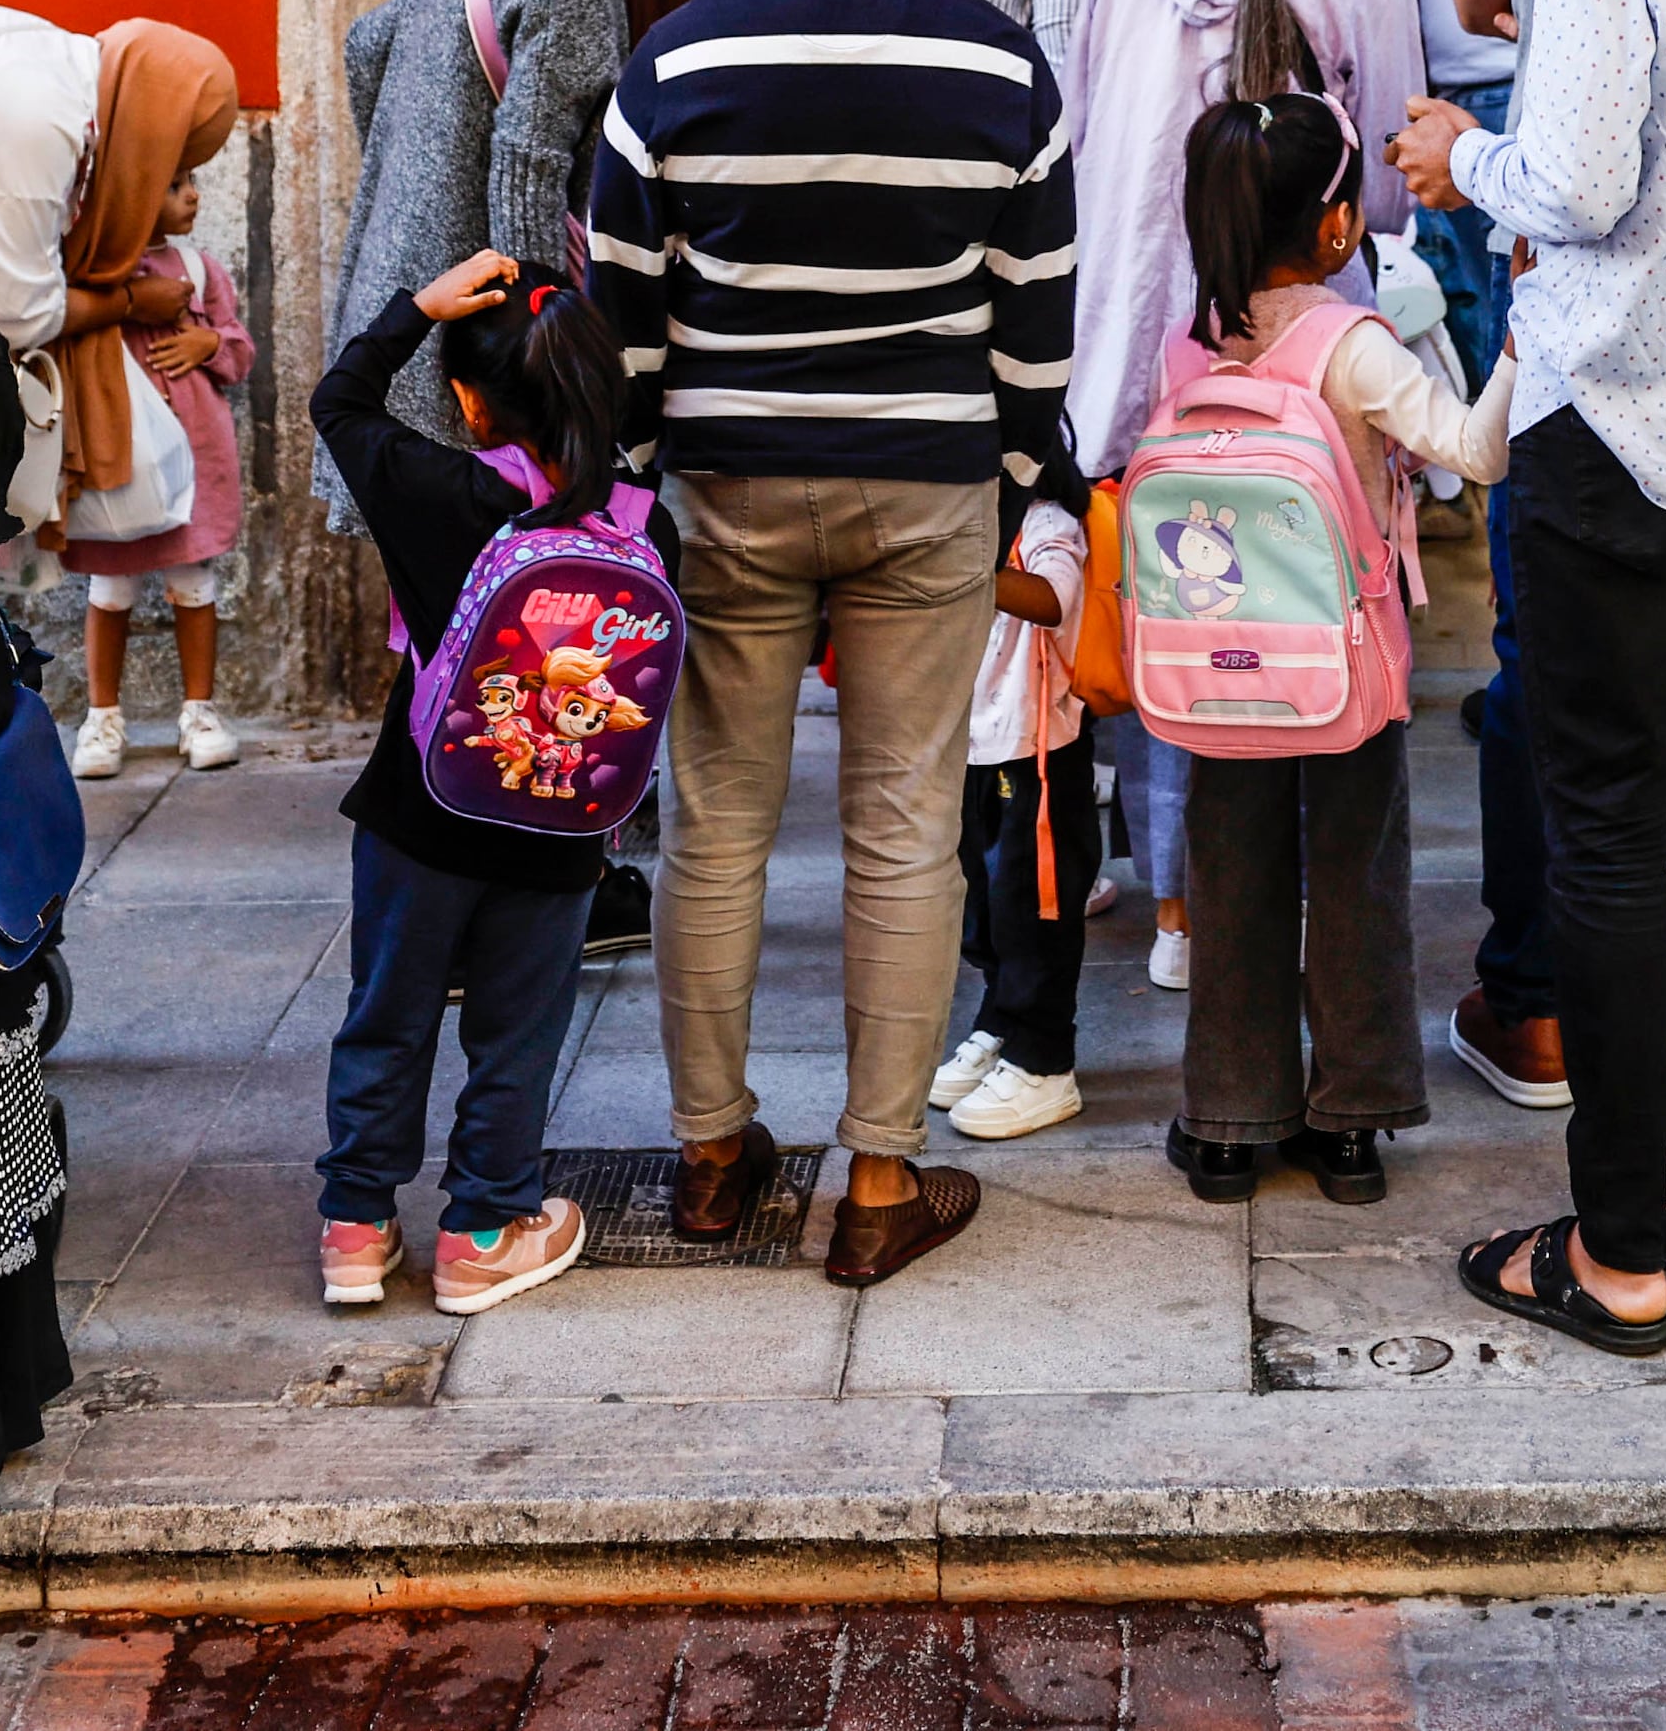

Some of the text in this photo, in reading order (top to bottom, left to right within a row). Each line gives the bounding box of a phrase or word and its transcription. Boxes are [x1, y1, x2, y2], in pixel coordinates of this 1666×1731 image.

[520, 588, 672, 657] City Girls
[1220, 653, 1251, 667] JBS
